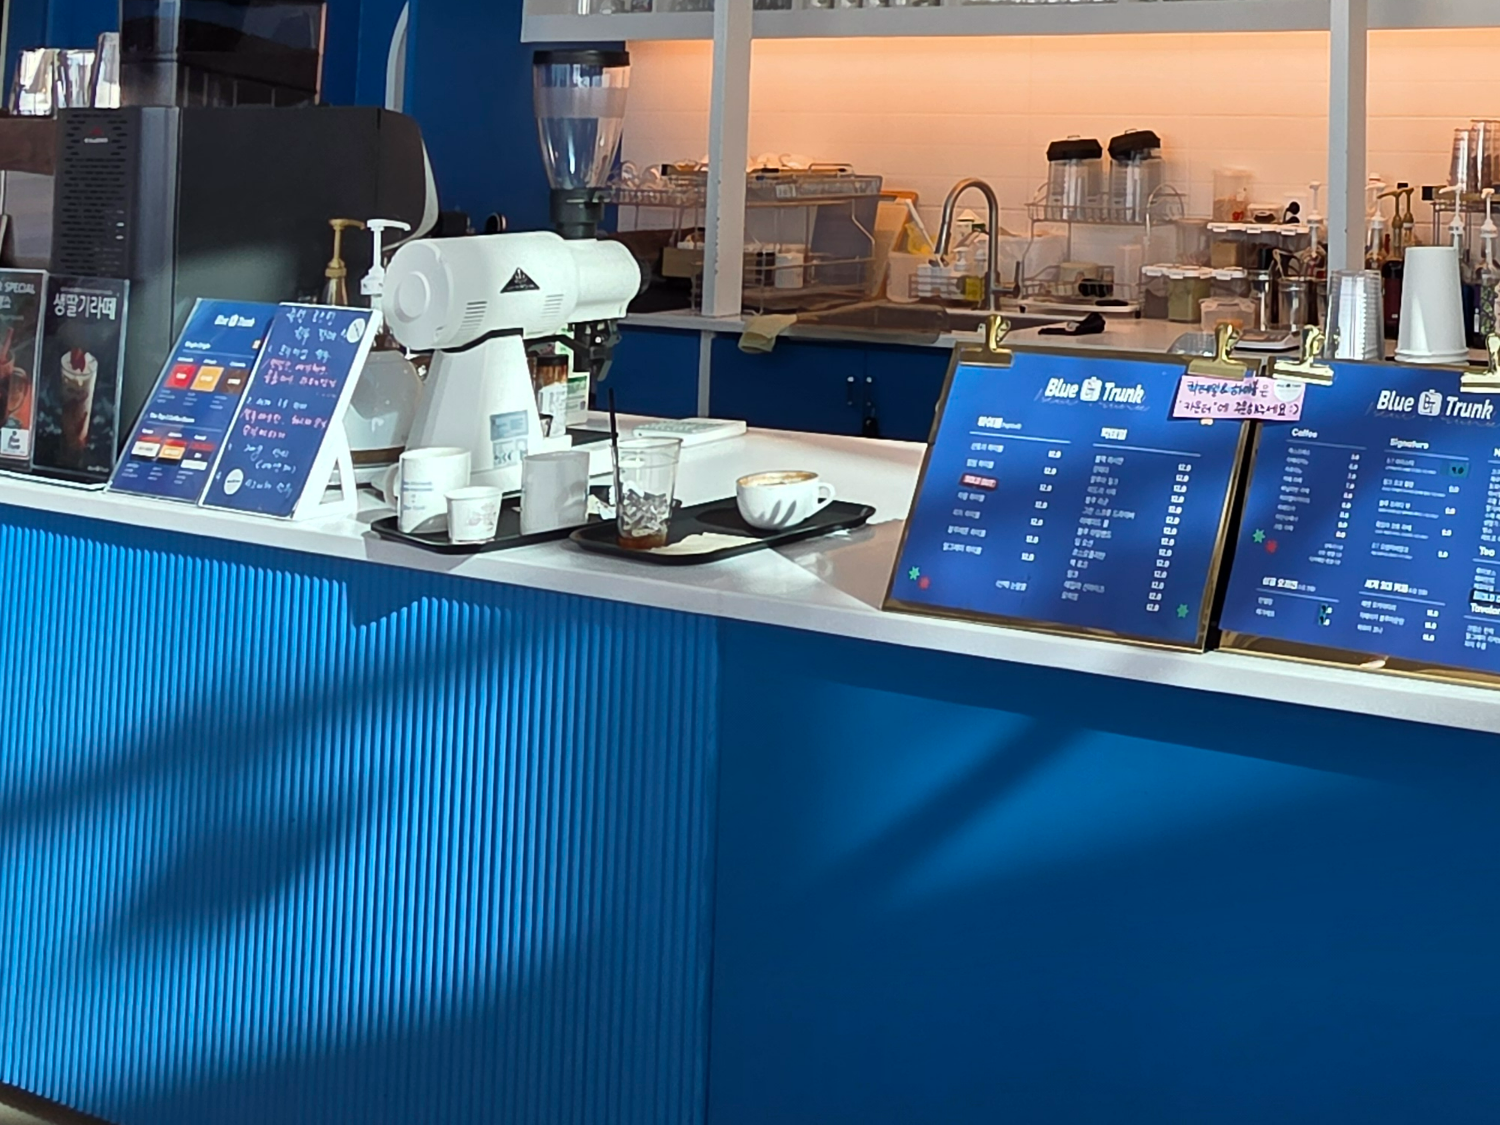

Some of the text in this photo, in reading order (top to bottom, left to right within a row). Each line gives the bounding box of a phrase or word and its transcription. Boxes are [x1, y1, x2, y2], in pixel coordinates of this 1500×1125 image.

[53, 292, 117, 321] 생딸기라떼
[1044, 377, 1145, 404] Blue Trunk
[1377, 390, 1494, 420] Blue Trunk
